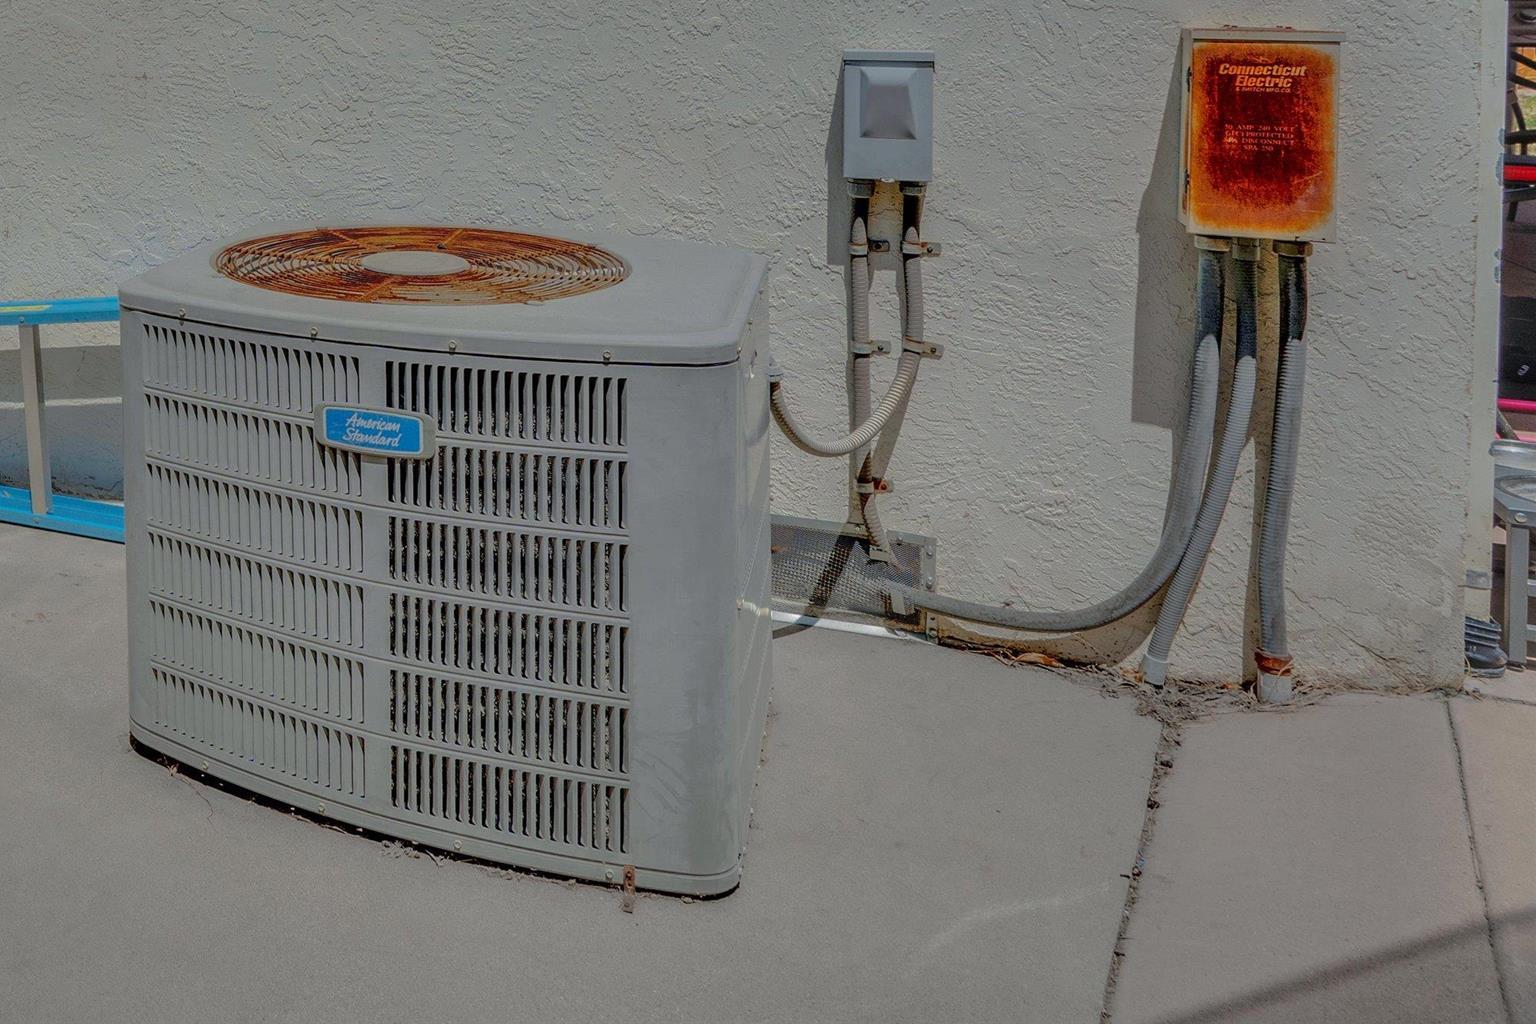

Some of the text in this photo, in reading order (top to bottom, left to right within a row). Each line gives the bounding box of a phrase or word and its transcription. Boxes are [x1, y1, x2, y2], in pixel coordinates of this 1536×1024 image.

[1218, 63, 1307, 76] Connecticut
[1235, 75, 1293, 87] Electric
[345, 412, 401, 433] American
[342, 427, 402, 447] Standard
